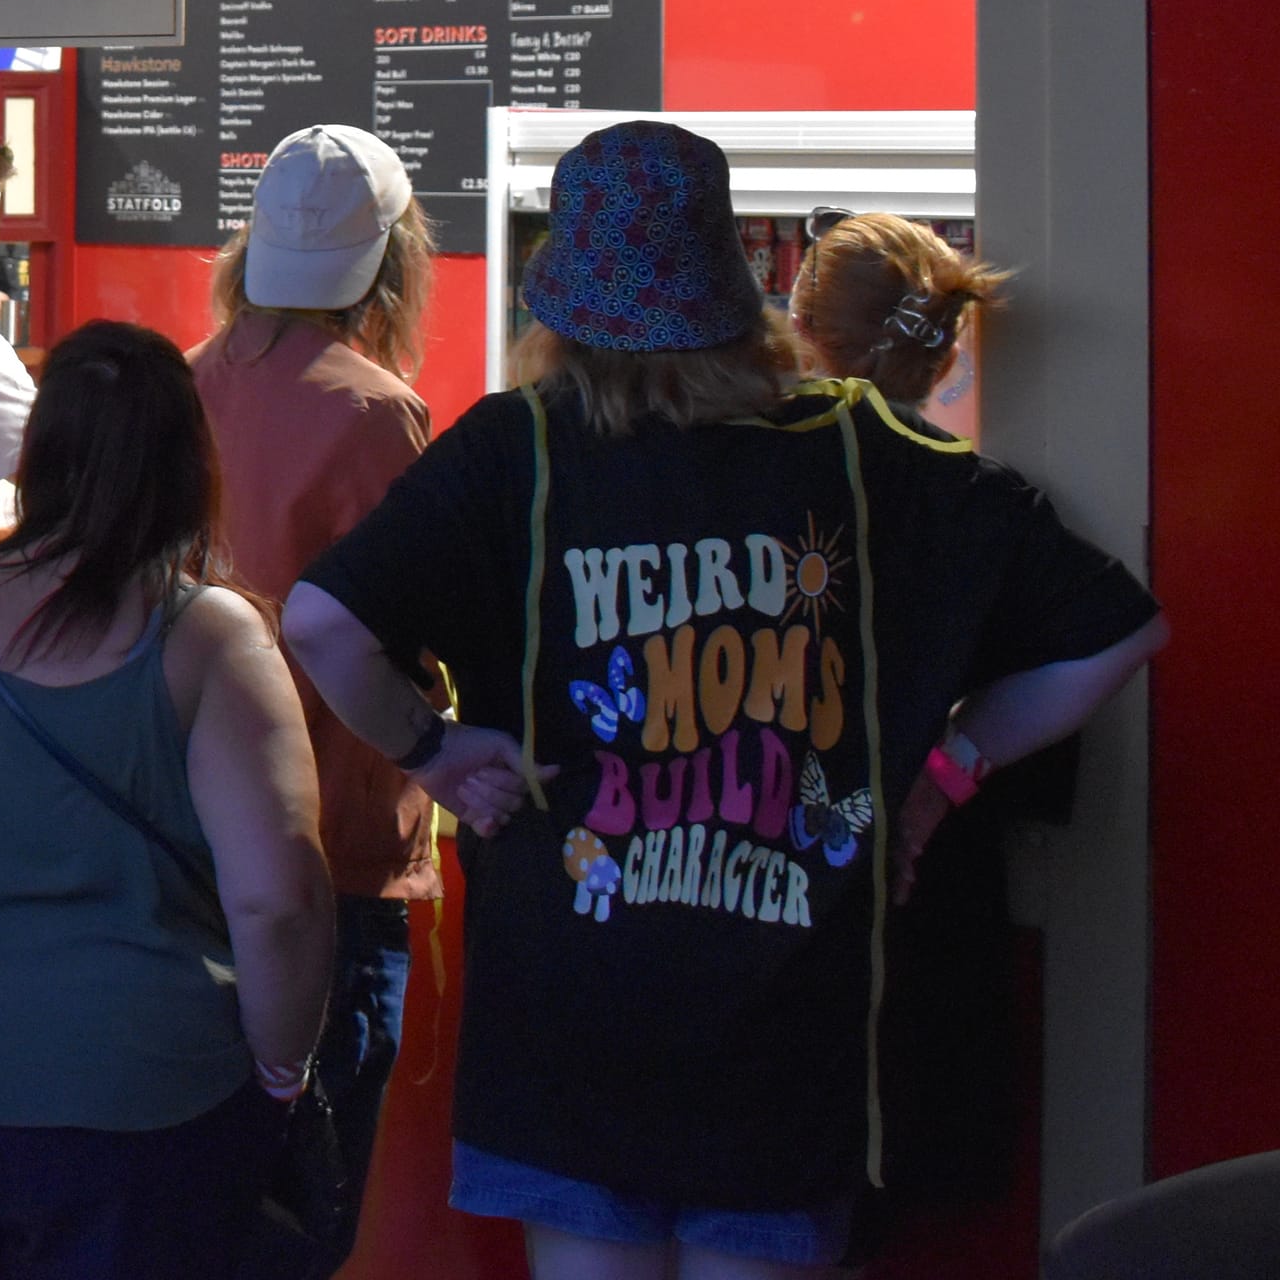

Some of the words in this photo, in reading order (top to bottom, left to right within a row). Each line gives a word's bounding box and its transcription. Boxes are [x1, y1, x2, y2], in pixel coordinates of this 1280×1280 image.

[101, 56, 181, 72] Hawkstone
[374, 27, 416, 44] SOFT
[421, 26, 487, 43] DRINKS
[220, 153, 268, 168] SHOTS
[107, 198, 181, 210] STATFOLD
[564, 534, 785, 648] WEIRD
[642, 624, 845, 752] MOMS
[585, 728, 792, 839] BUILD
[623, 824, 811, 927] CHARACTER
